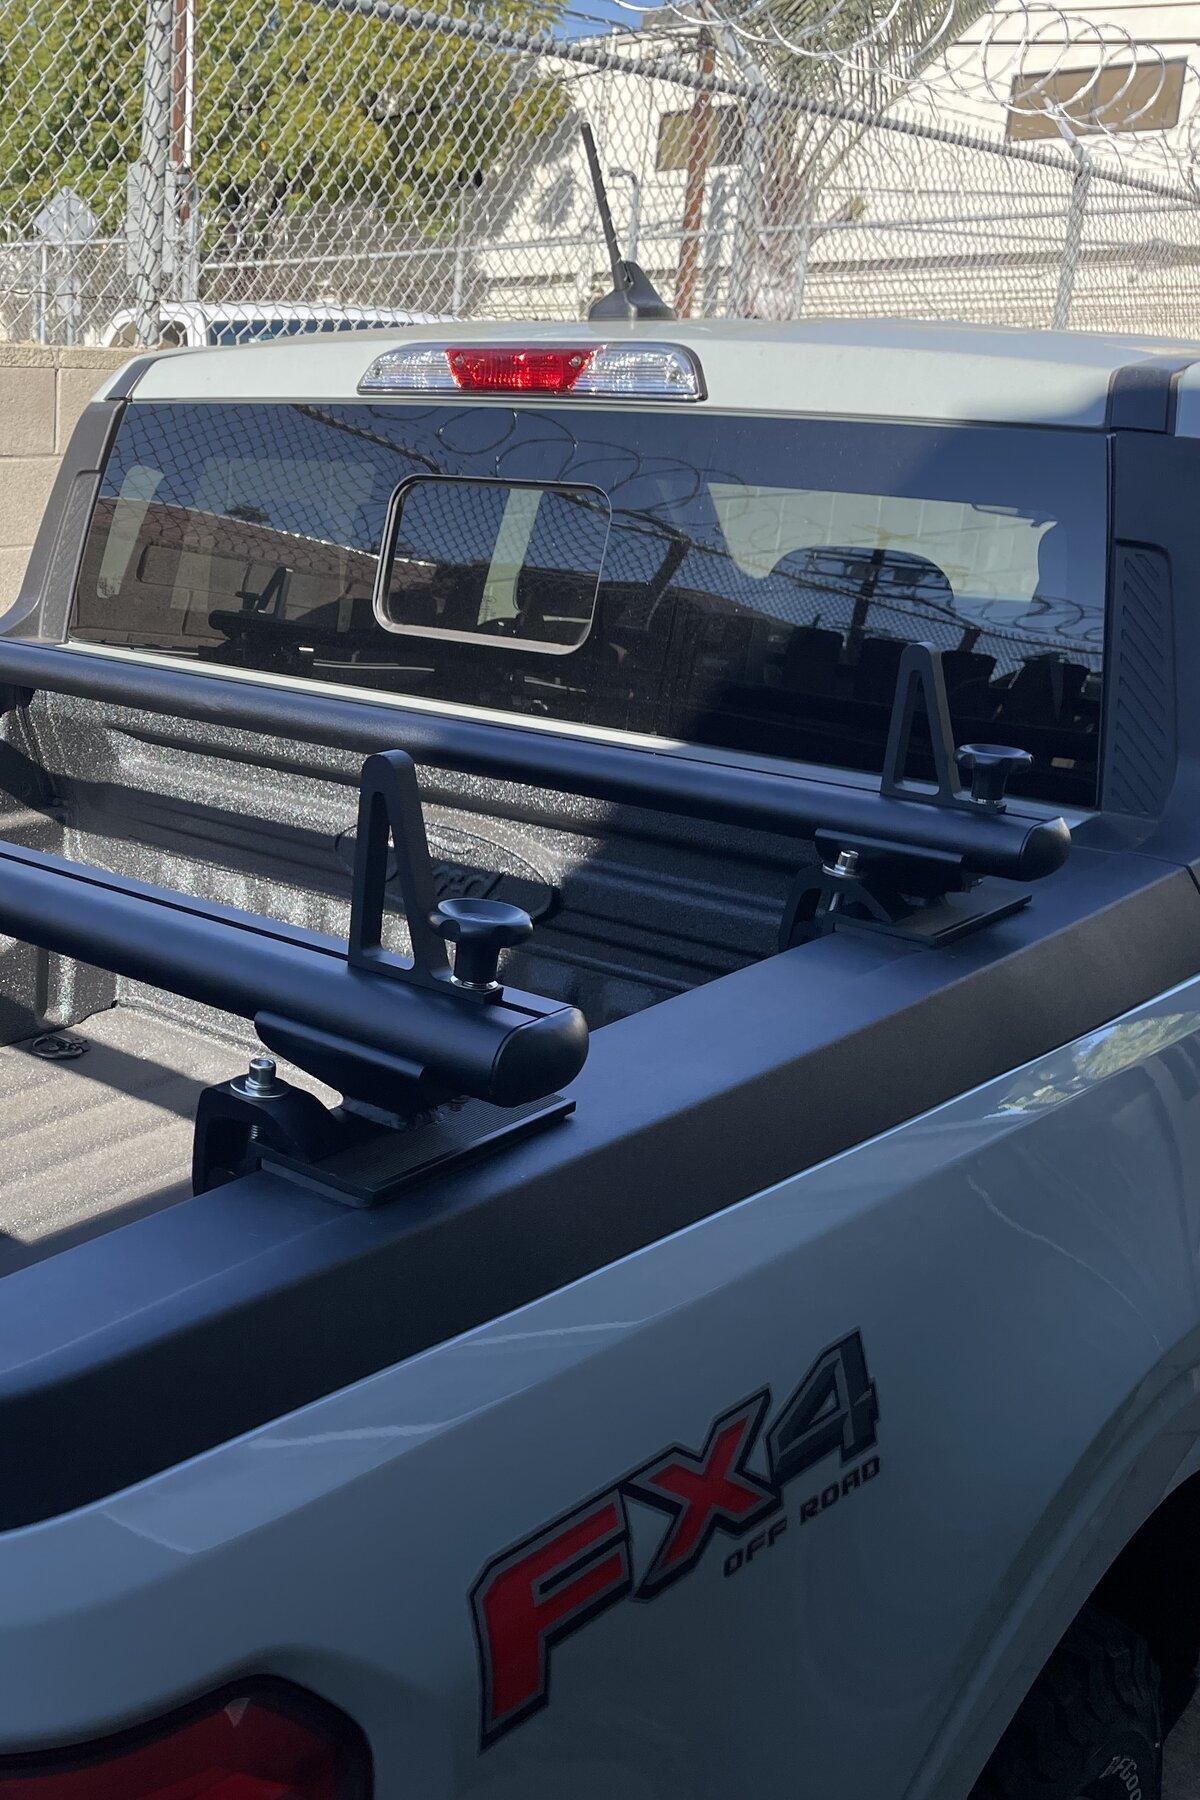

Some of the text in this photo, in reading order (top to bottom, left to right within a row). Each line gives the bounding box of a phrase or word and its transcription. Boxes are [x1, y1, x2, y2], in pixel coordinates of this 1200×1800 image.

[469, 1326, 880, 1757] FX4
[723, 1456, 880, 1578] OFF ROAD
